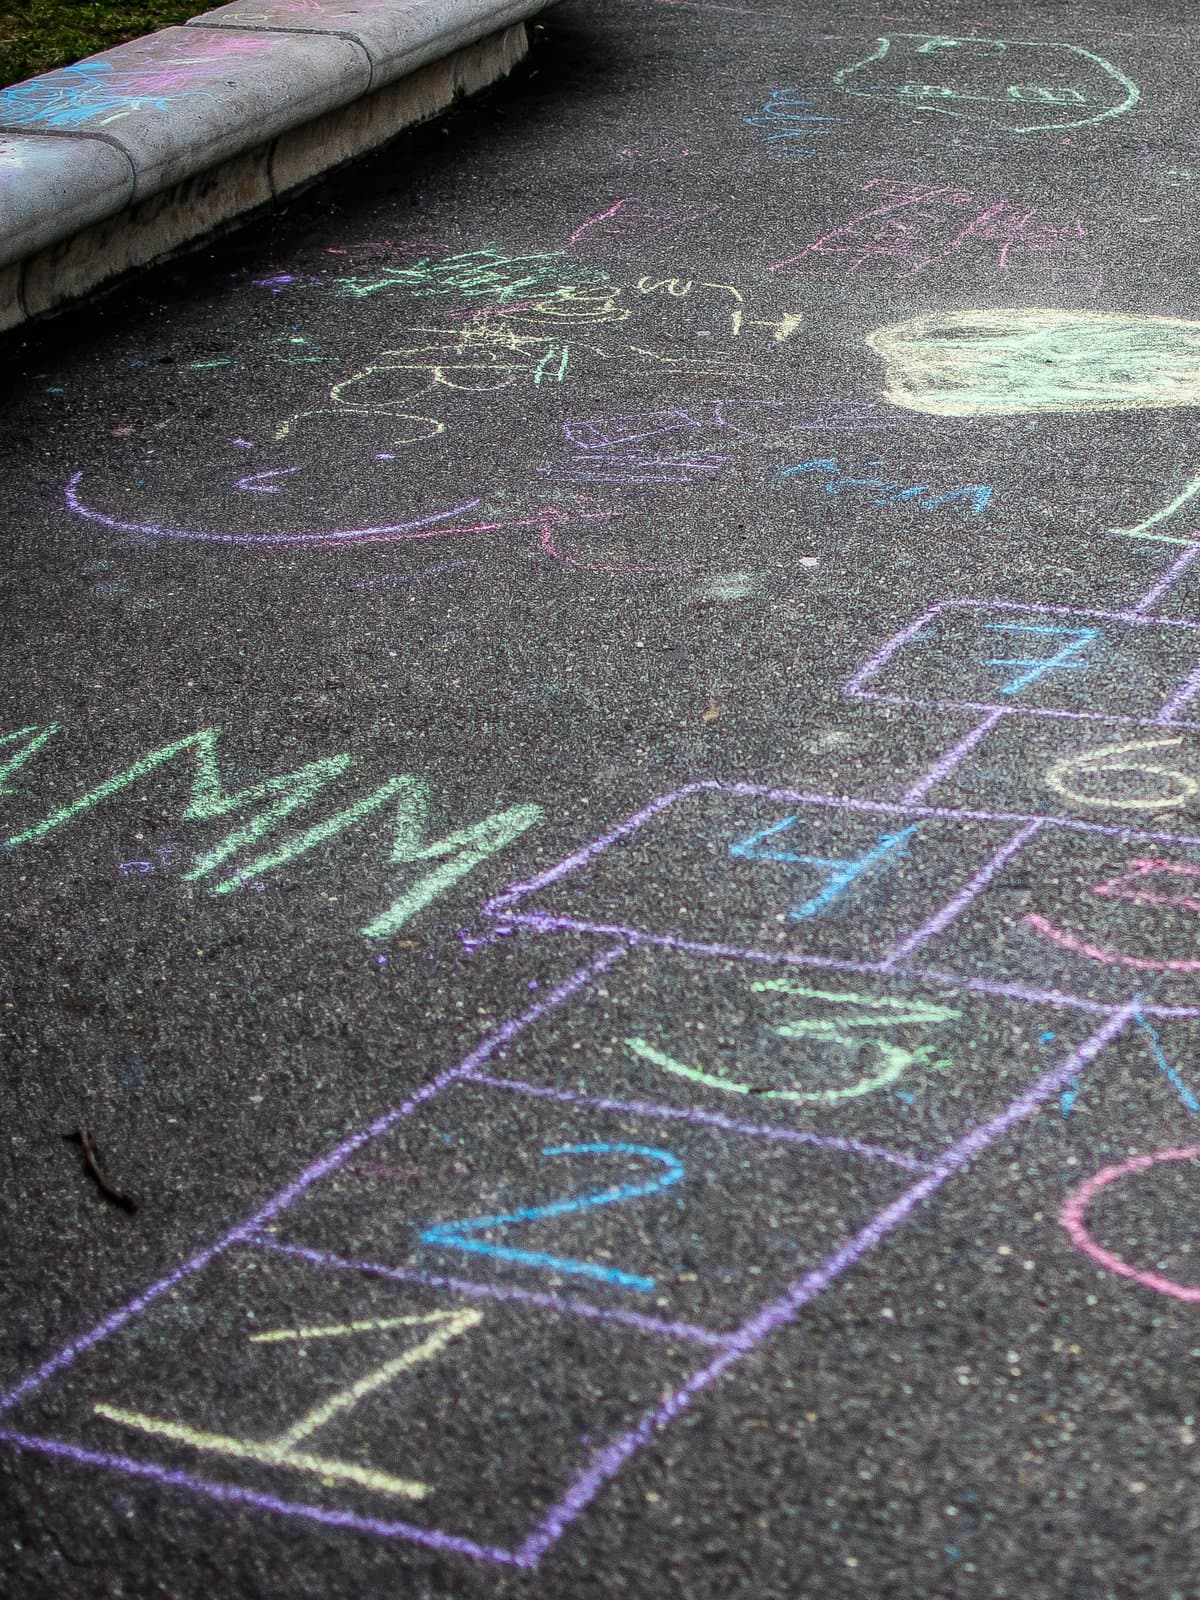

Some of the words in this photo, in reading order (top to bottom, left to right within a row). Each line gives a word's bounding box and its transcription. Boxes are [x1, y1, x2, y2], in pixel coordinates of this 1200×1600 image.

[984, 624, 1100, 695] 7
[1044, 737, 1200, 808] 6
[728, 815, 918, 920] 4
[626, 977, 963, 1100] 3
[420, 1142, 684, 1291] 2
[93, 1307, 484, 1500] 1
